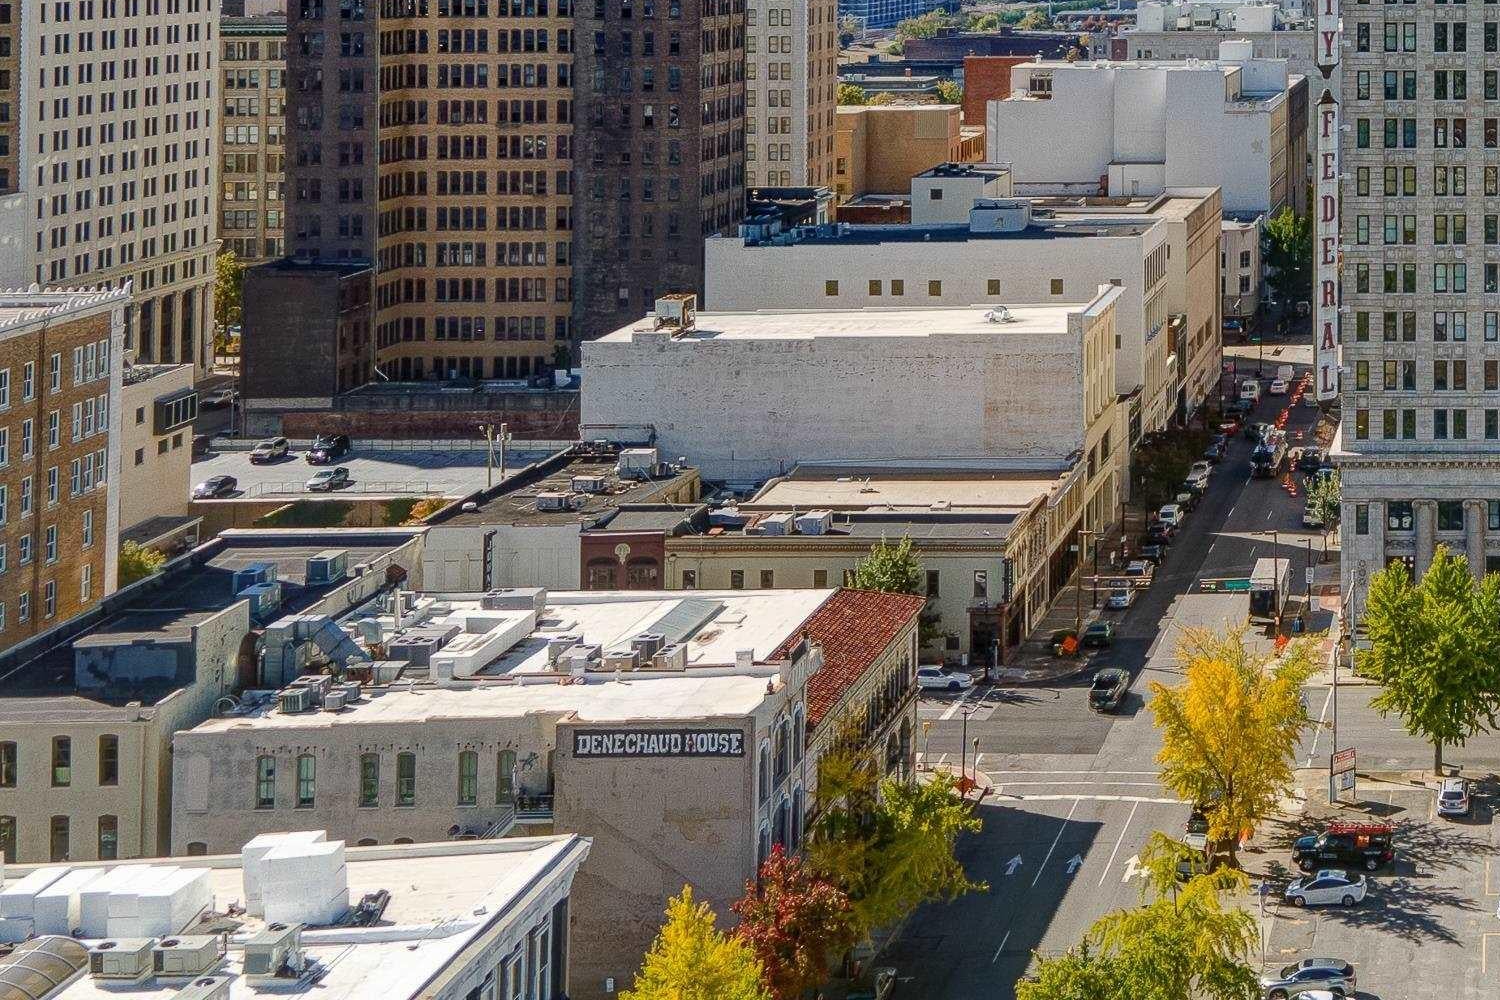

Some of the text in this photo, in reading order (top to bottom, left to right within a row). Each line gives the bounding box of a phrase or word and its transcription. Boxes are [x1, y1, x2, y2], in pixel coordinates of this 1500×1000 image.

[1321, 110, 1336, 393] FEDERAL
[576, 733, 742, 754] DENECHAUD HOUSE
